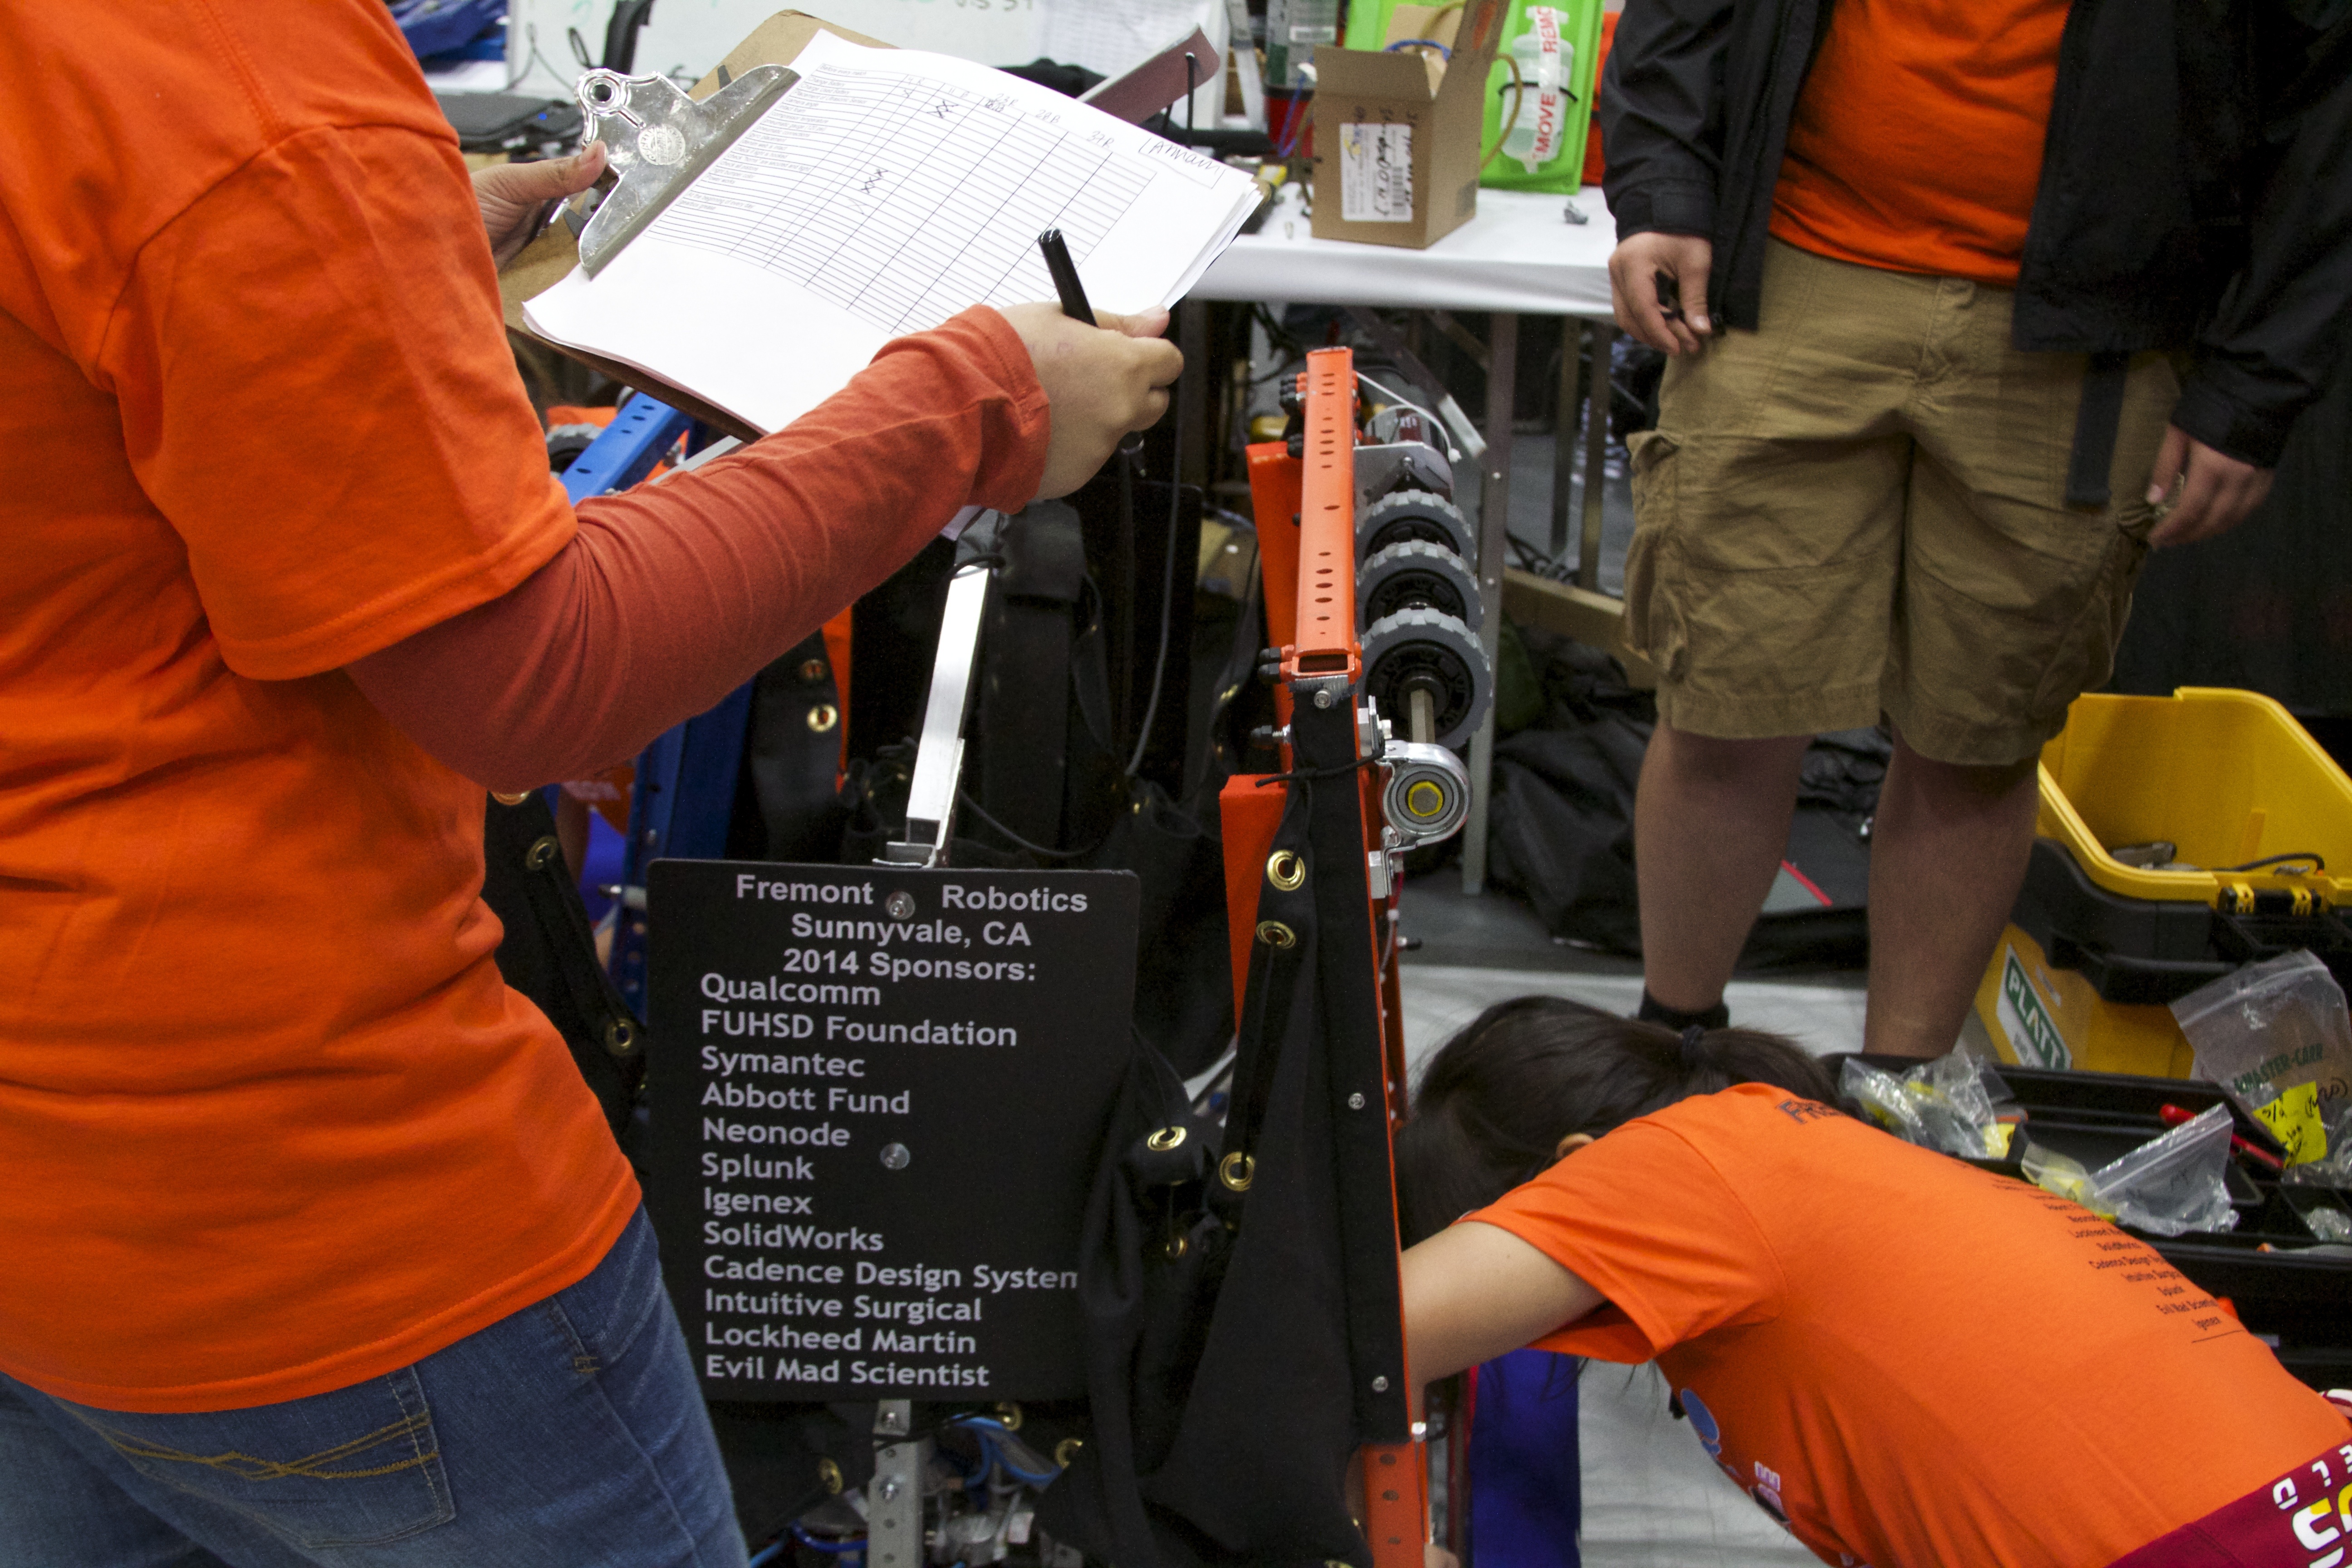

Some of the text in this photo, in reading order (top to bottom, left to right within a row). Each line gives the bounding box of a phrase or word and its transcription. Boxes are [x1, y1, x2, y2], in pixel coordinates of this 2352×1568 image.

[1533, 93, 1557, 158] MOVE
[737, 874, 1088, 912] Fremont Robotics
[791, 912, 1032, 947] Sunnyvale, CA
[783, 948, 1035, 983] 2014 Sponsors:
[701, 972, 883, 1006] Qualcomm
[702, 1009, 1017, 1047] FUHSD Foundation
[2008, 966, 2062, 1069] PLATT
[701, 1046, 865, 1077] Symantec
[701, 1082, 910, 1114] Abbott Fund
[704, 1117, 850, 1147] Neonode
[701, 1152, 814, 1182] Splunk
[705, 1186, 812, 1217] Igenex
[704, 1221, 884, 1252] SolidWorks
[704, 1254, 844, 1284] Cadence
[856, 1261, 961, 1293] Design
[706, 1288, 982, 1325] Intuitive Surgical
[706, 1322, 976, 1354] Lockheed Martin
[706, 1355, 990, 1387] Evil Mad Scientist
